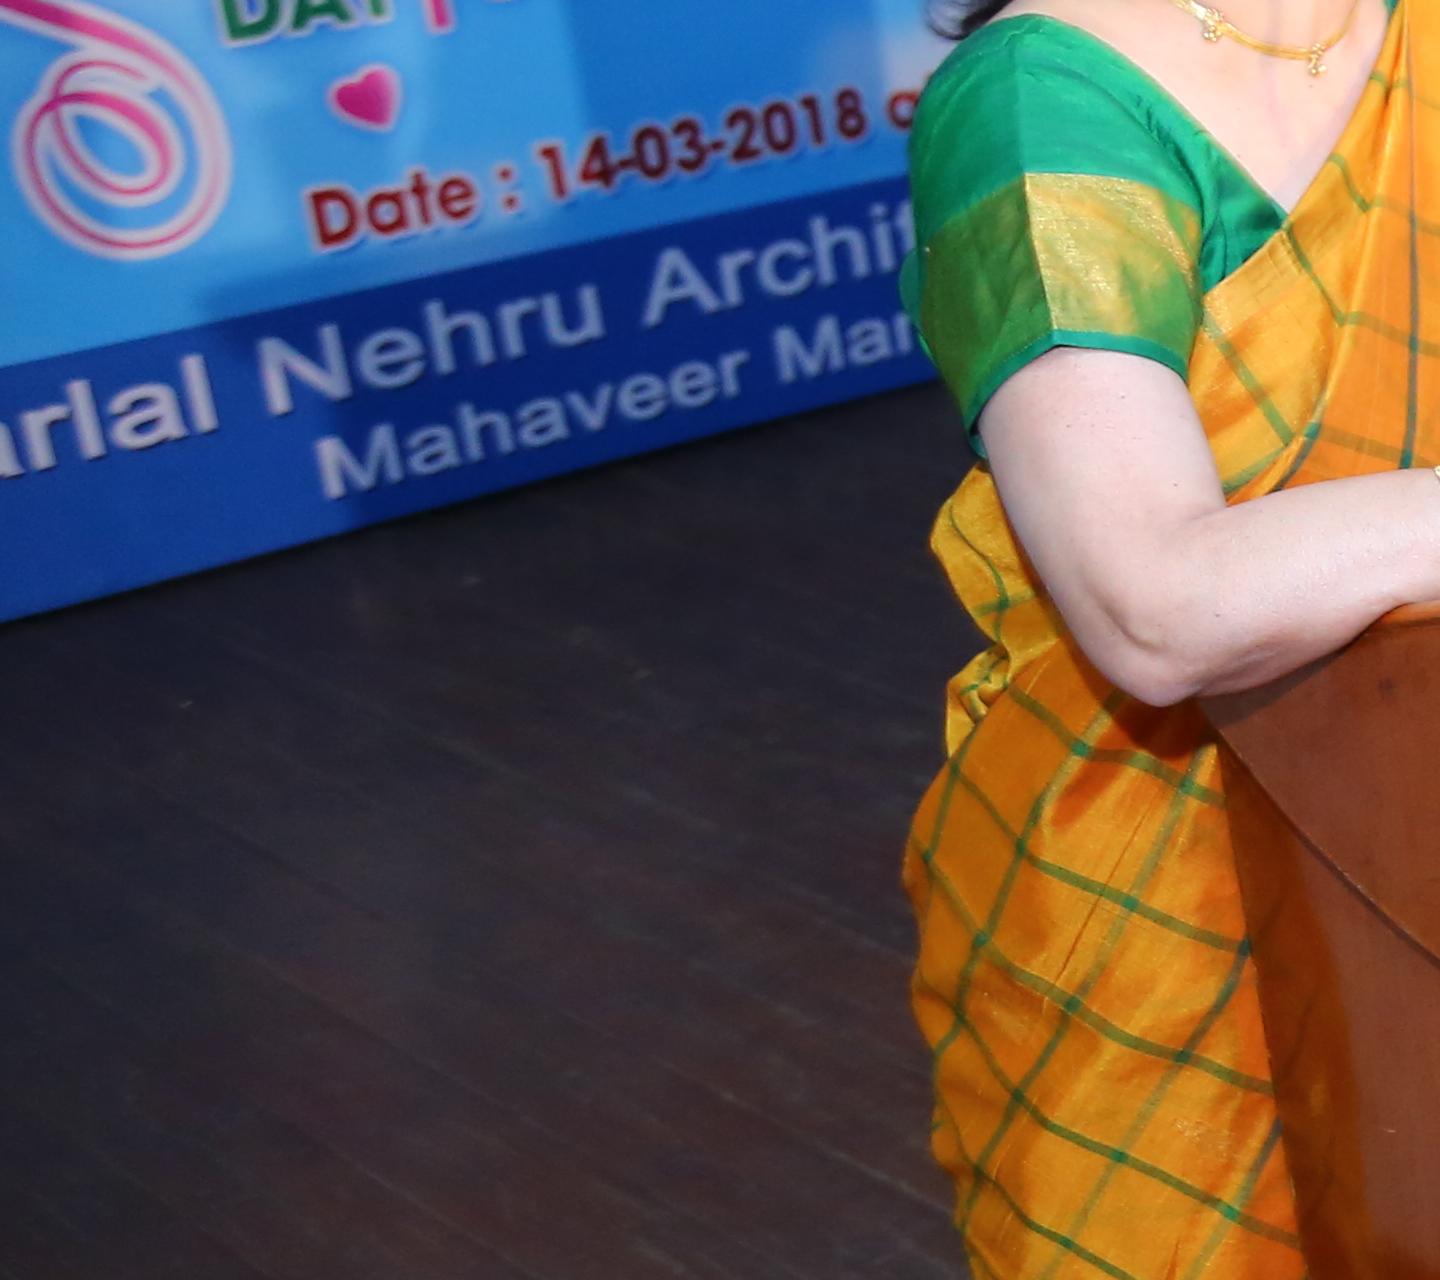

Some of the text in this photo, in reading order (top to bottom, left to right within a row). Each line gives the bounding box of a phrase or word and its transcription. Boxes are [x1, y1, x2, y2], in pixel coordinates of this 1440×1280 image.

[308, 178, 478, 250] Date
[538, 86, 868, 201] 14-03-2018
[258, 281, 606, 416] Nehru
[317, 348, 750, 500] Mahaveer
